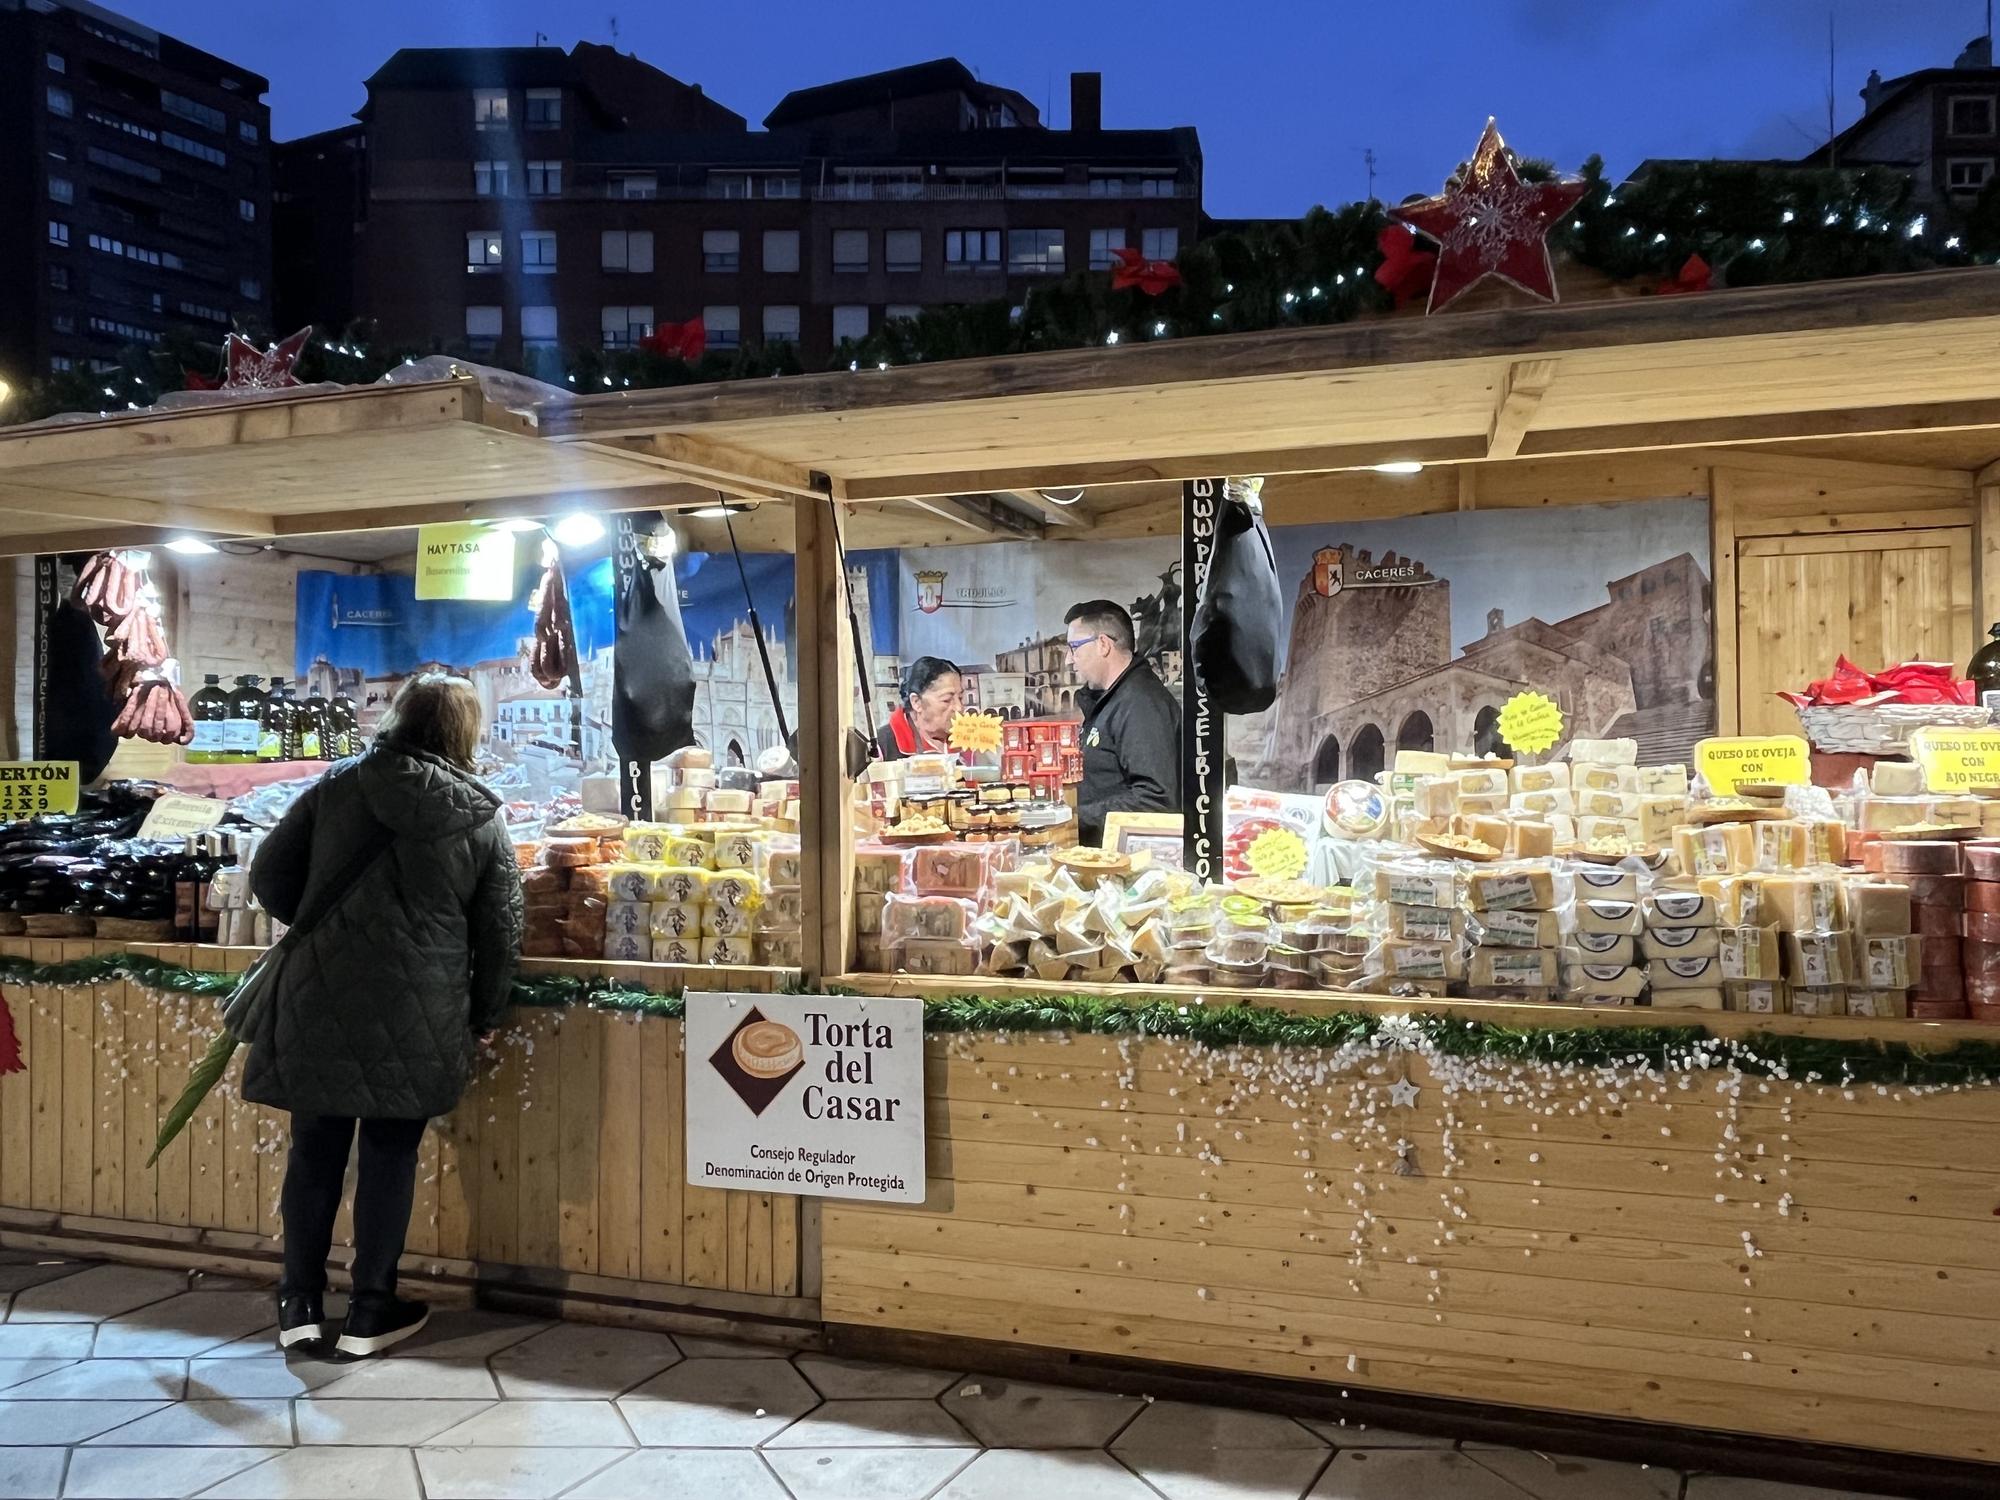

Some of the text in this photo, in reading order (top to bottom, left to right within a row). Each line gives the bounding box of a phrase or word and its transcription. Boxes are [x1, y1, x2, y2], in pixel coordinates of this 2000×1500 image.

[427, 543, 481, 555] HAY TASA
[1355, 566, 1415, 580] CACERES
[1963, 741, 1978, 752] DE
[1708, 747, 1797, 760] QUESO DE OVEJA
[1741, 763, 1763, 773] CON
[1961, 757, 1985, 767] CON
[1945, 772, 1967, 784] AJO
[4, 784, 48, 797] 1 X 5
[2, 797, 49, 810] 2 X 9
[804, 1013, 893, 1049] Torta
[825, 1051, 873, 1085] del
[802, 1085, 900, 1122] Casar
[750, 1144, 856, 1165] Consejo Regulador
[705, 1162, 905, 1193] Denominación de Origen Protegida
